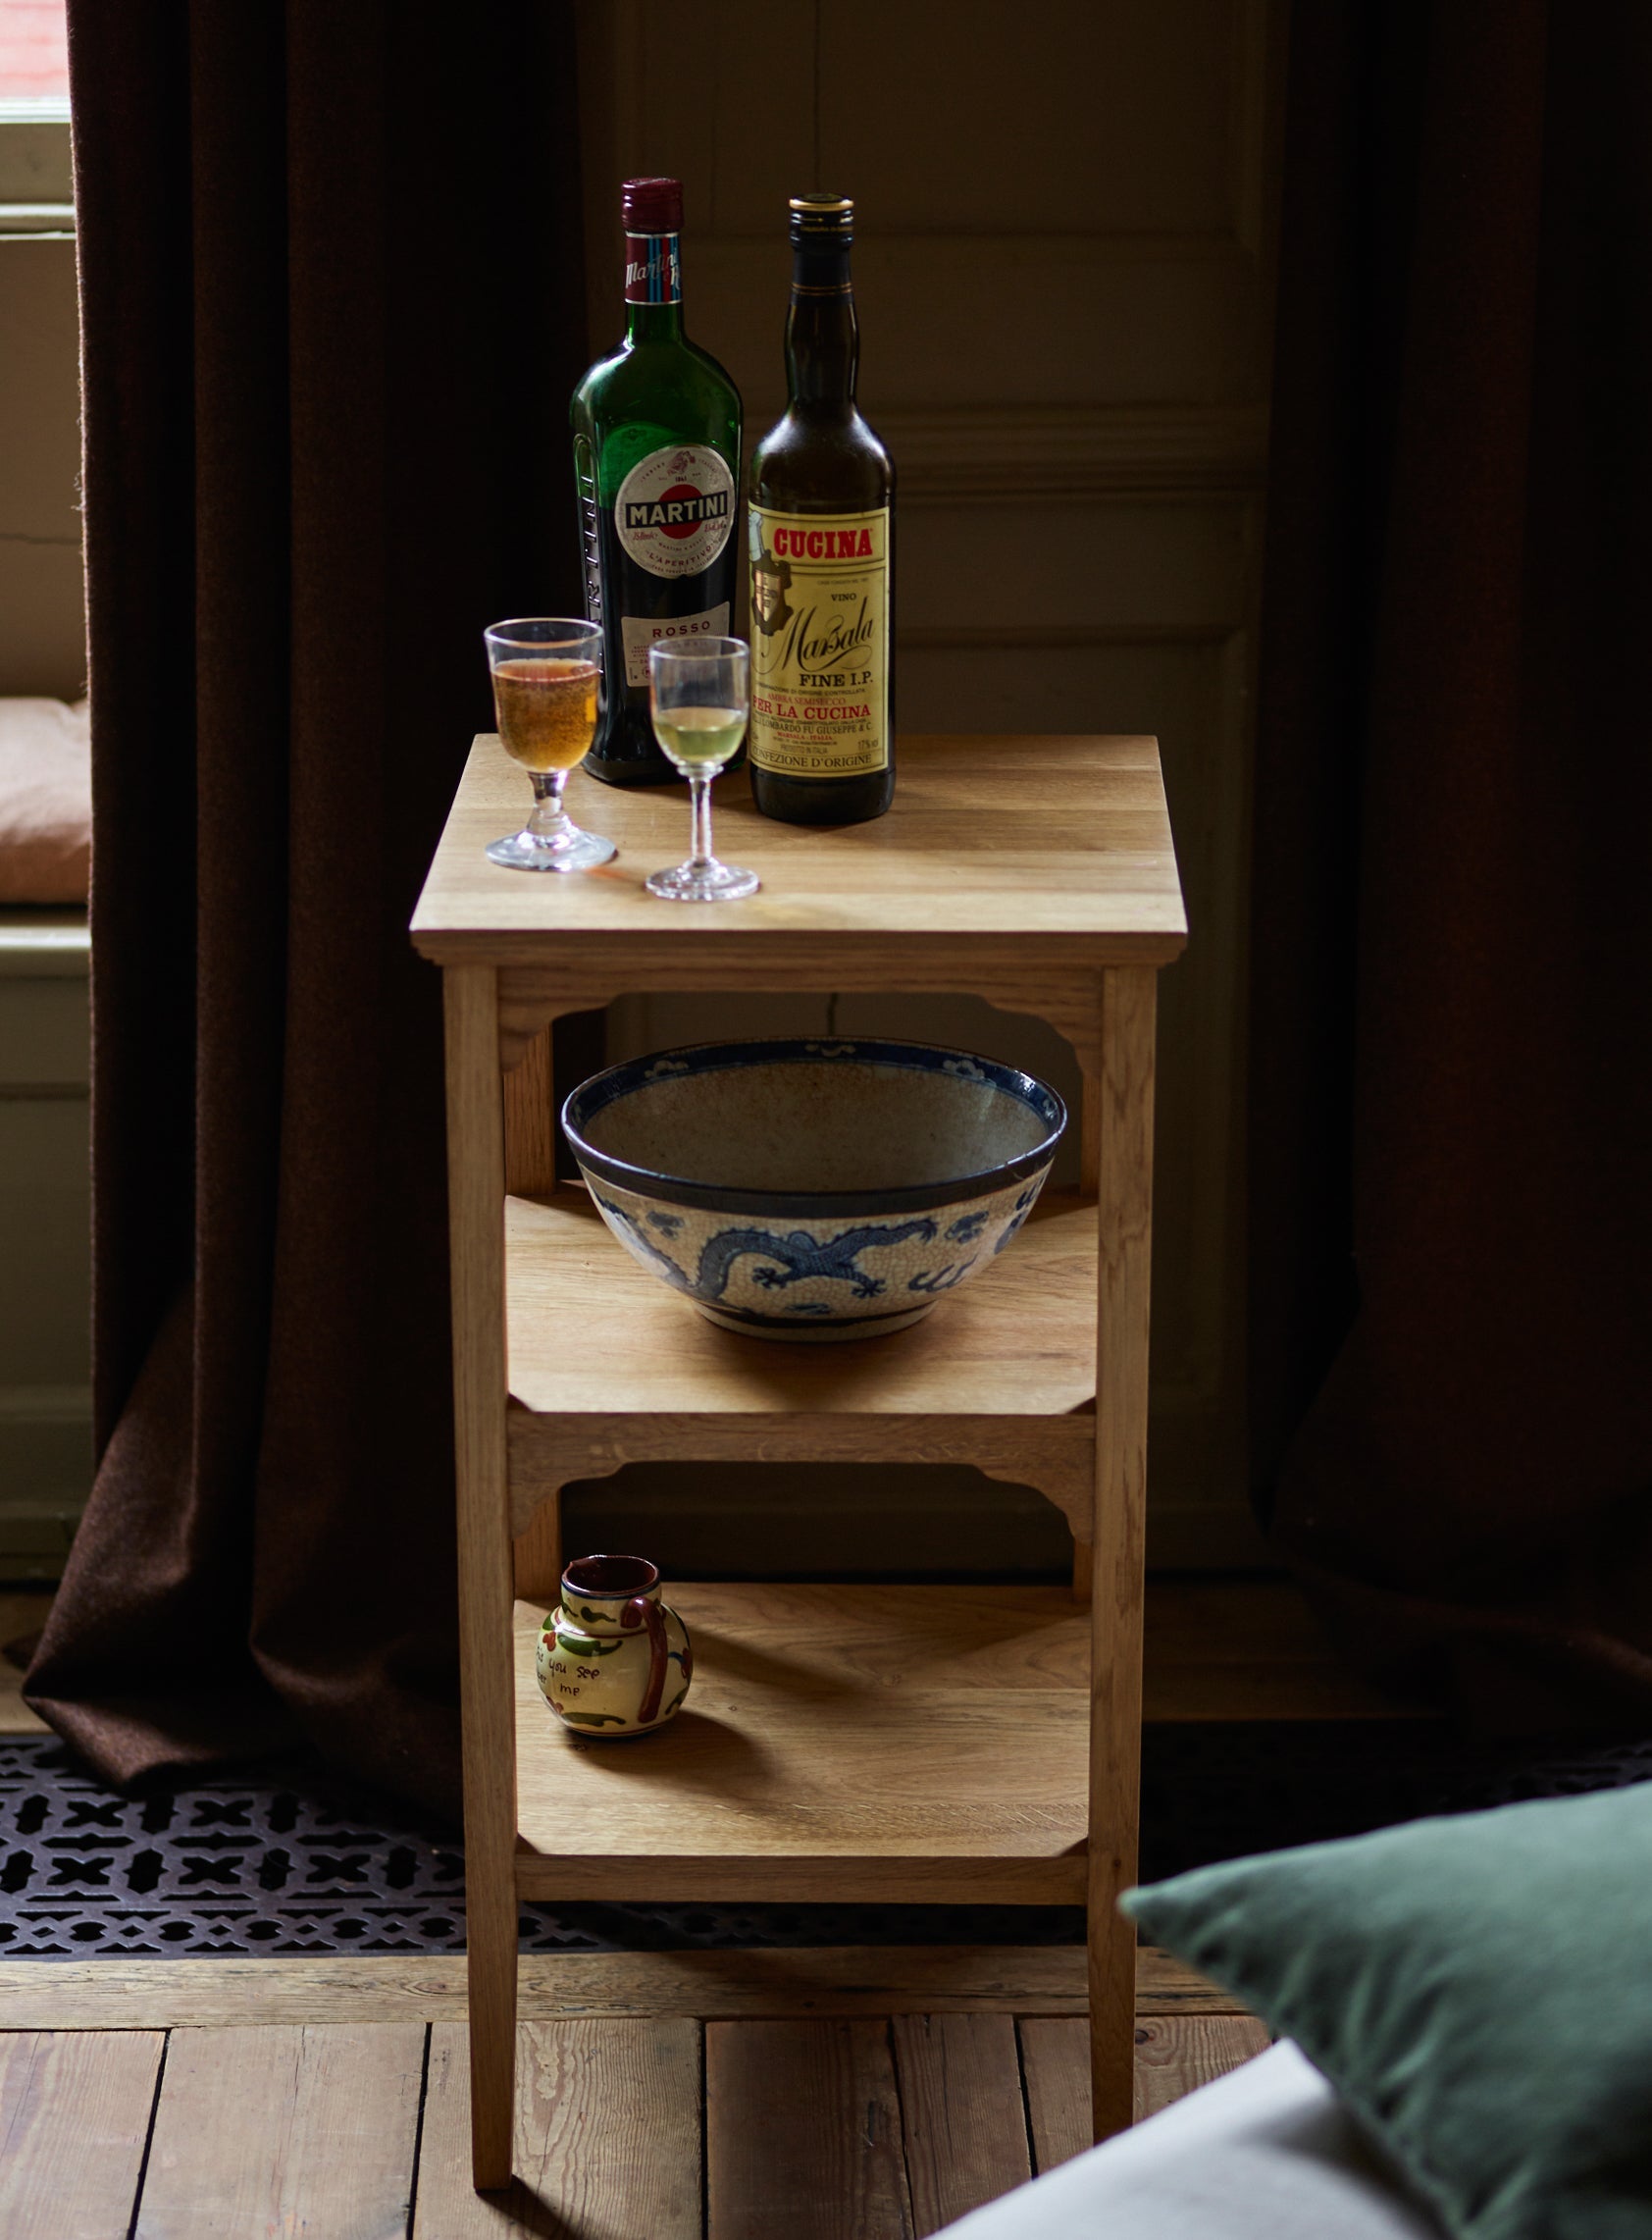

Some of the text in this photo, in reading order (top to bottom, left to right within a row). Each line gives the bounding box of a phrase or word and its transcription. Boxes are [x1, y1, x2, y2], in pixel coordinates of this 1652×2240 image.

[629, 494, 726, 527] MARTINI
[773, 528, 873, 559] CUCINA
[831, 593, 857, 602] VINO
[652, 620, 710, 638] ROSSO
[753, 596, 874, 675] Marsala
[800, 670, 874, 688] FINE I.P.
[752, 694, 871, 720] PER LA CUCINA
[802, 724, 814, 735] FU
[816, 723, 858, 735] GIUSEPPE
[811, 754, 872, 768] D'ORIGINE
[548, 1658, 567, 1678] you
[576, 1666, 600, 1681] see
[559, 1682, 581, 1697] me
